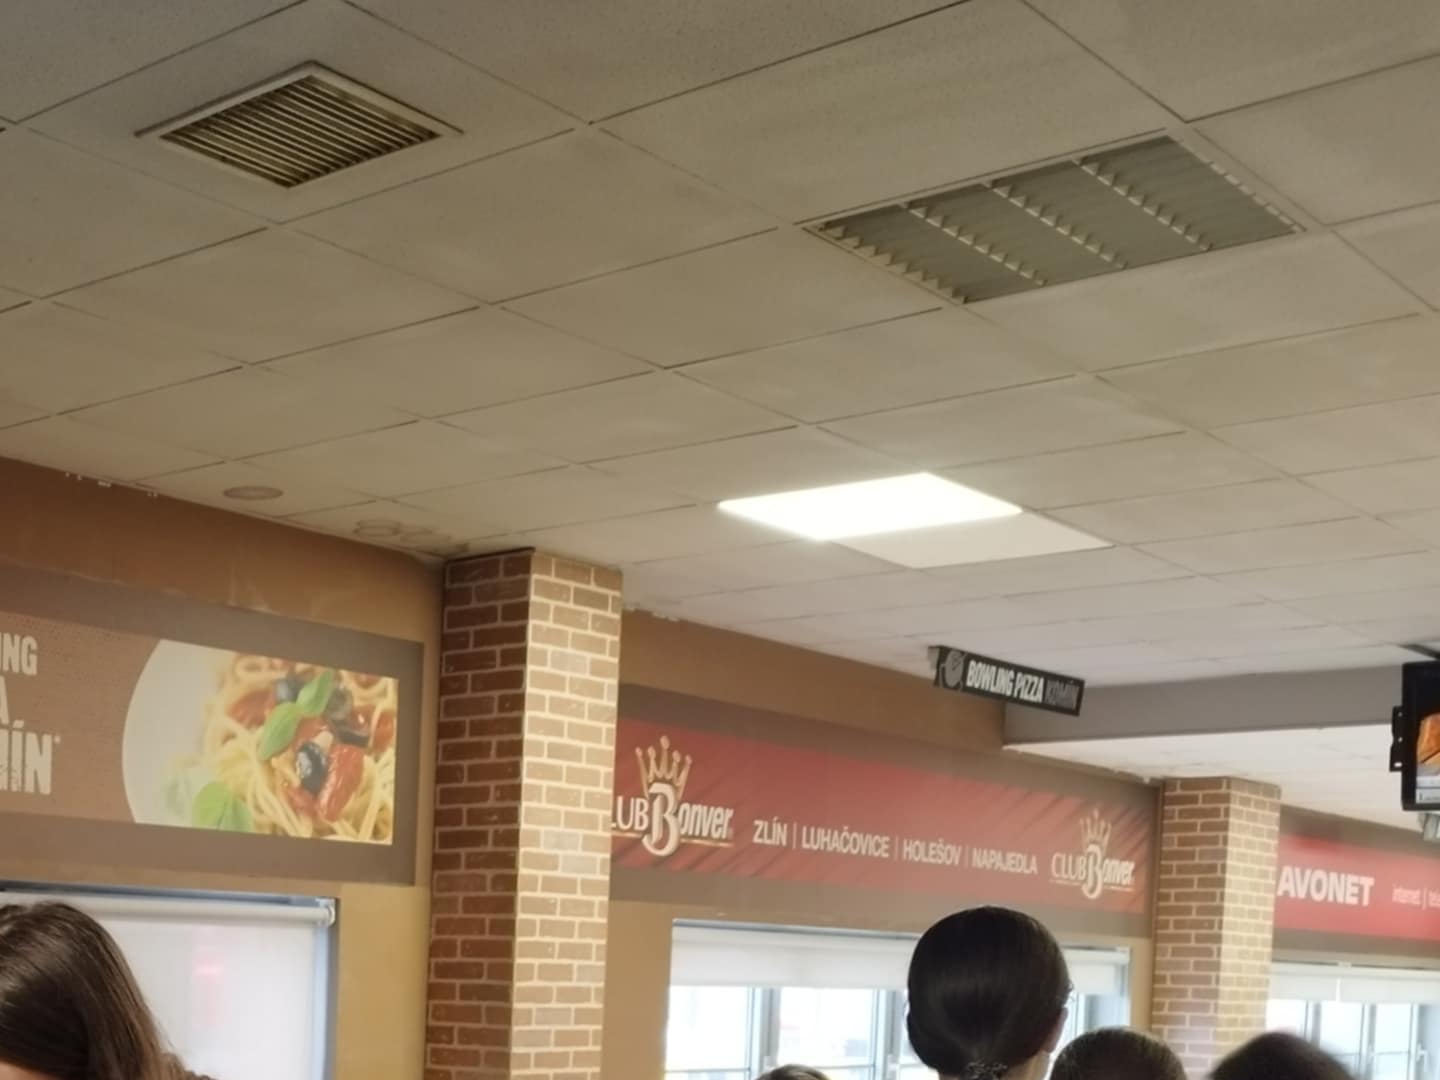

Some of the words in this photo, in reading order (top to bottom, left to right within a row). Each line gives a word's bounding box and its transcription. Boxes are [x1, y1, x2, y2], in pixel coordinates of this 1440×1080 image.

[965, 660, 1015, 697] BOWLING
[1014, 671, 1045, 704] PIZZA
[752, 816, 788, 847] ZLÍN
[801, 825, 891, 858] LUHAČOVICE
[903, 837, 962, 867] HOLEŠOV
[1051, 851, 1087, 880] CLUB
[1277, 865, 1375, 907] AVONET
